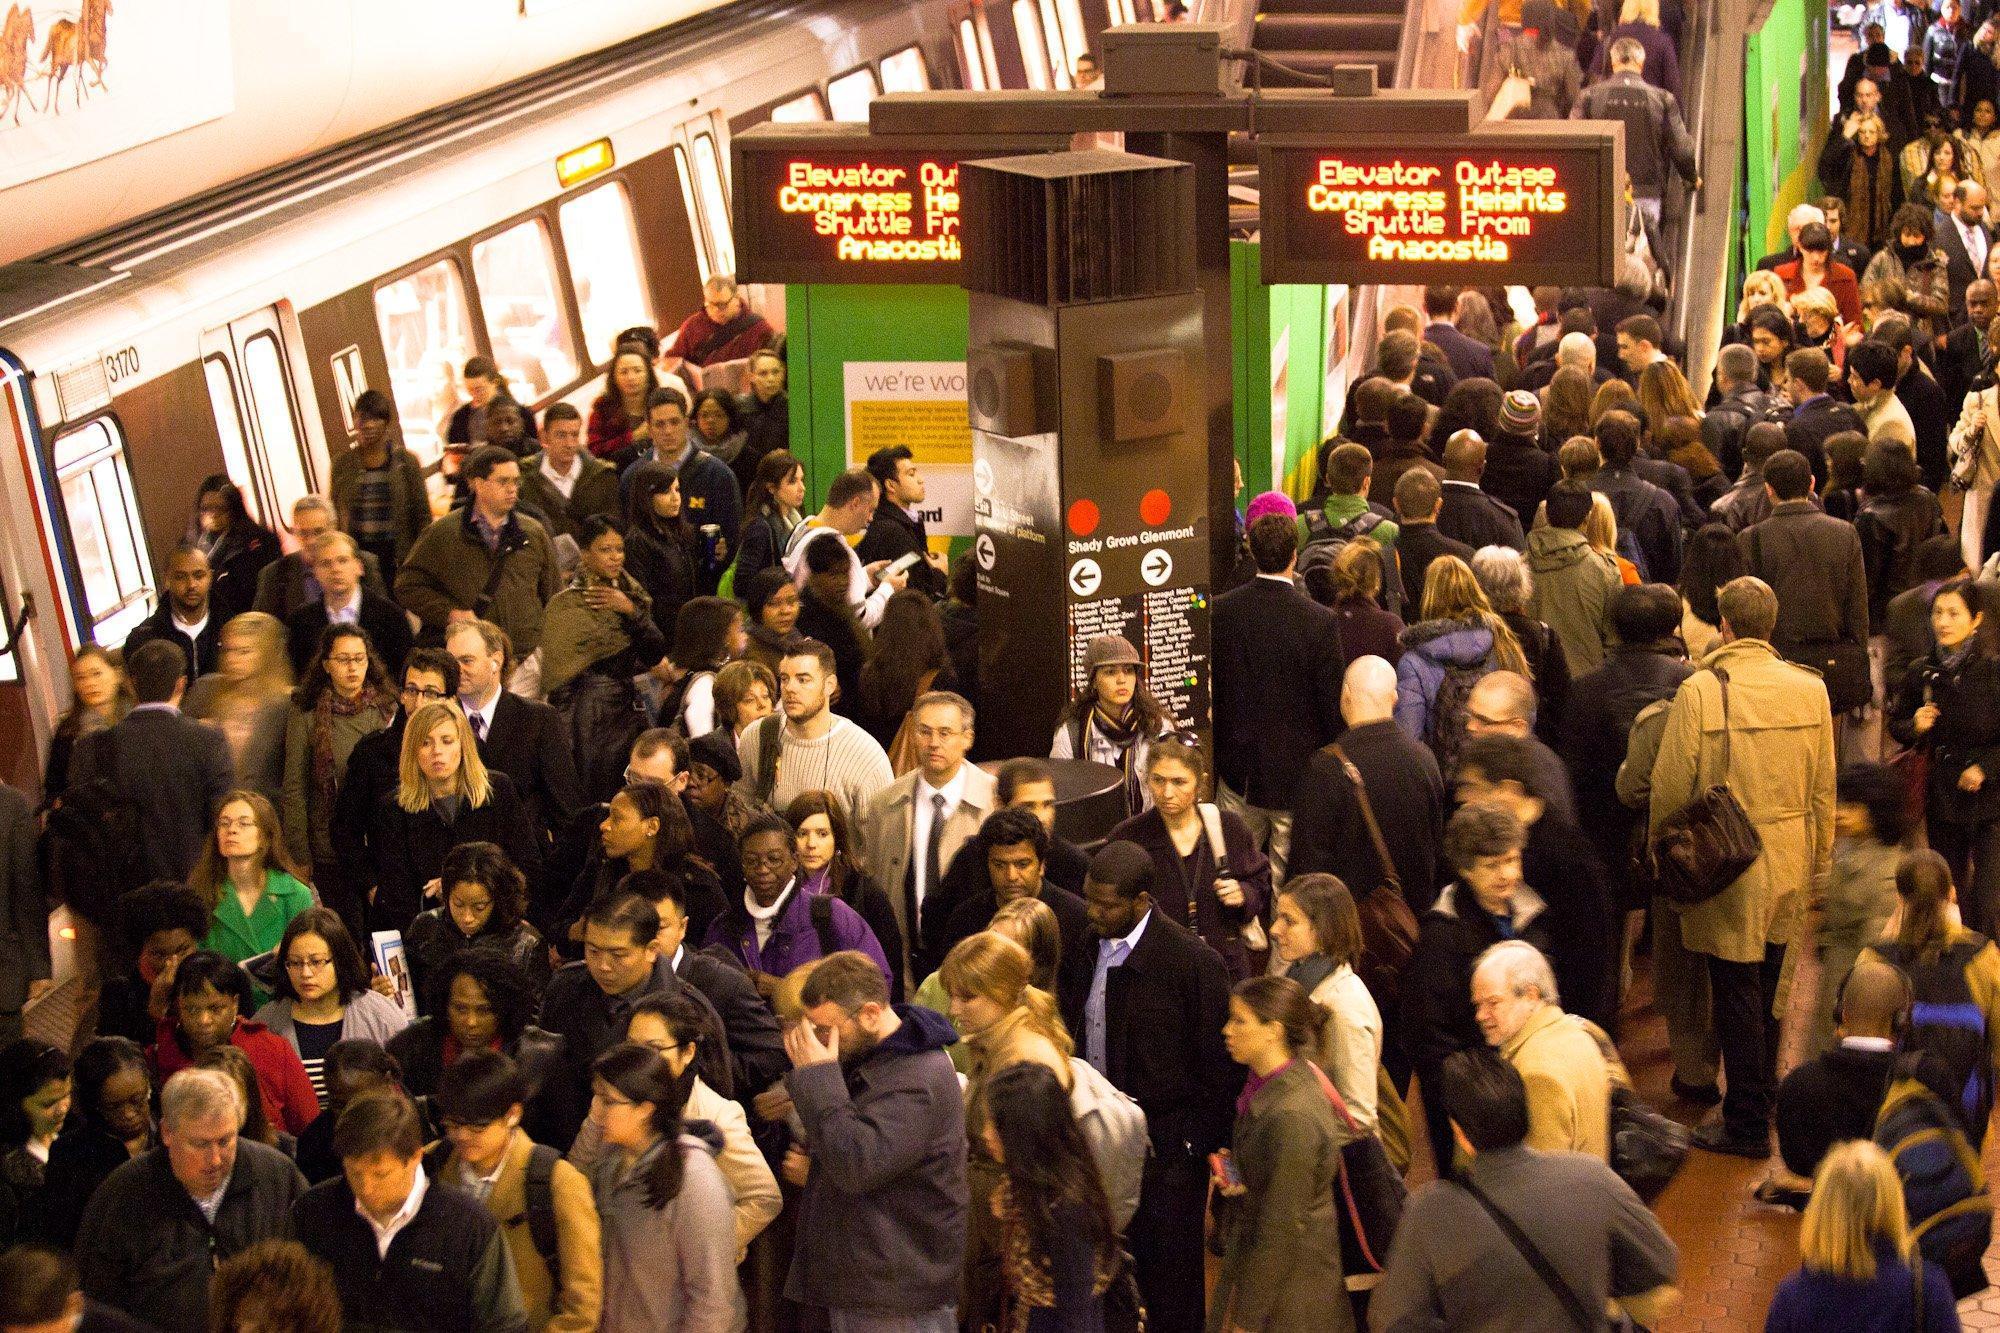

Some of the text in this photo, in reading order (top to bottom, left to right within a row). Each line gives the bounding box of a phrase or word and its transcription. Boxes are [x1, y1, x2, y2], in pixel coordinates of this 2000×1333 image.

[789, 161, 906, 188] Elevator
[1318, 160, 1557, 187] Elevator Outage
[779, 186, 913, 213] Congress
[1307, 184, 1567, 213] Congress Heights
[814, 210, 913, 235] Shuttle
[1344, 209, 1531, 235] Shuttle From
[1367, 234, 1509, 261] Anacostia
[106, 345, 140, 383] 3170
[864, 370, 925, 392] we're
[1068, 535, 1139, 554] Shady Grove
[1140, 525, 1194, 544] Glenmont
